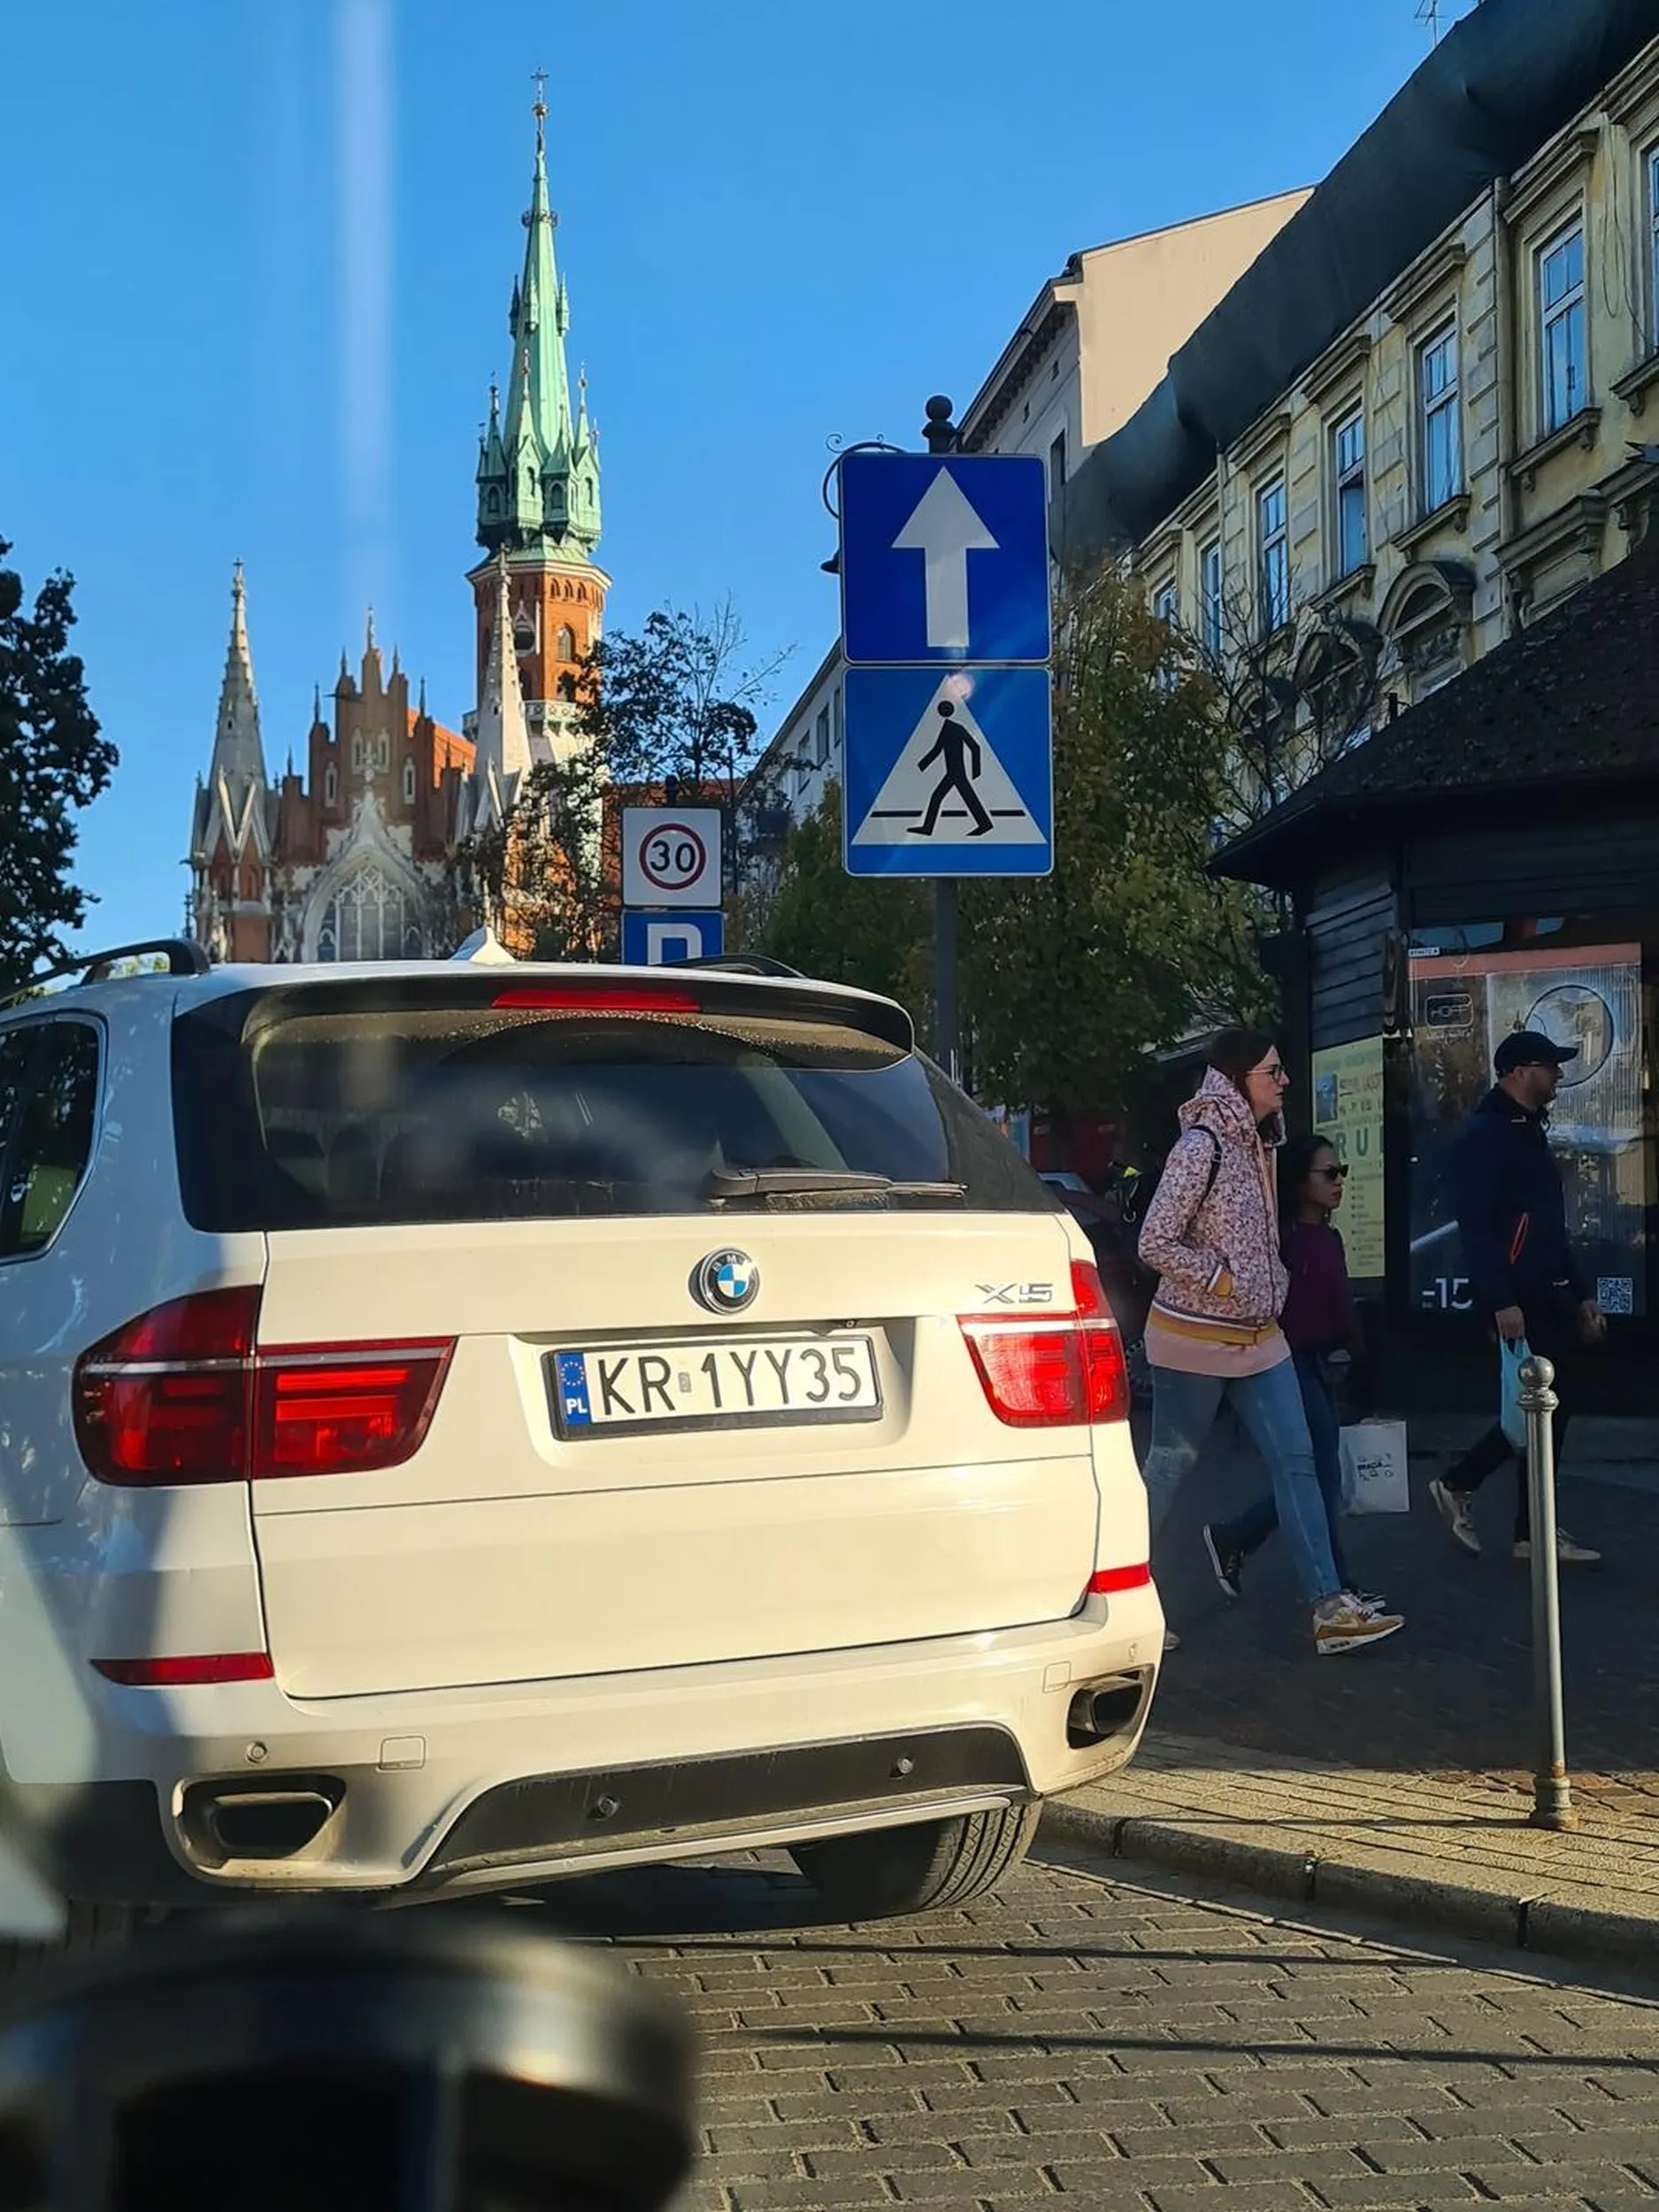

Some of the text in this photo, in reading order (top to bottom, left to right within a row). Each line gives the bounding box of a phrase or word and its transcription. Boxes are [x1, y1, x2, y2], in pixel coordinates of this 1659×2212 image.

[649, 840, 695, 873] 30
[974, 1282, 1054, 1304] X5
[598, 1348, 862, 1416] KR 1YY35
[566, 1398, 588, 1414] PL
